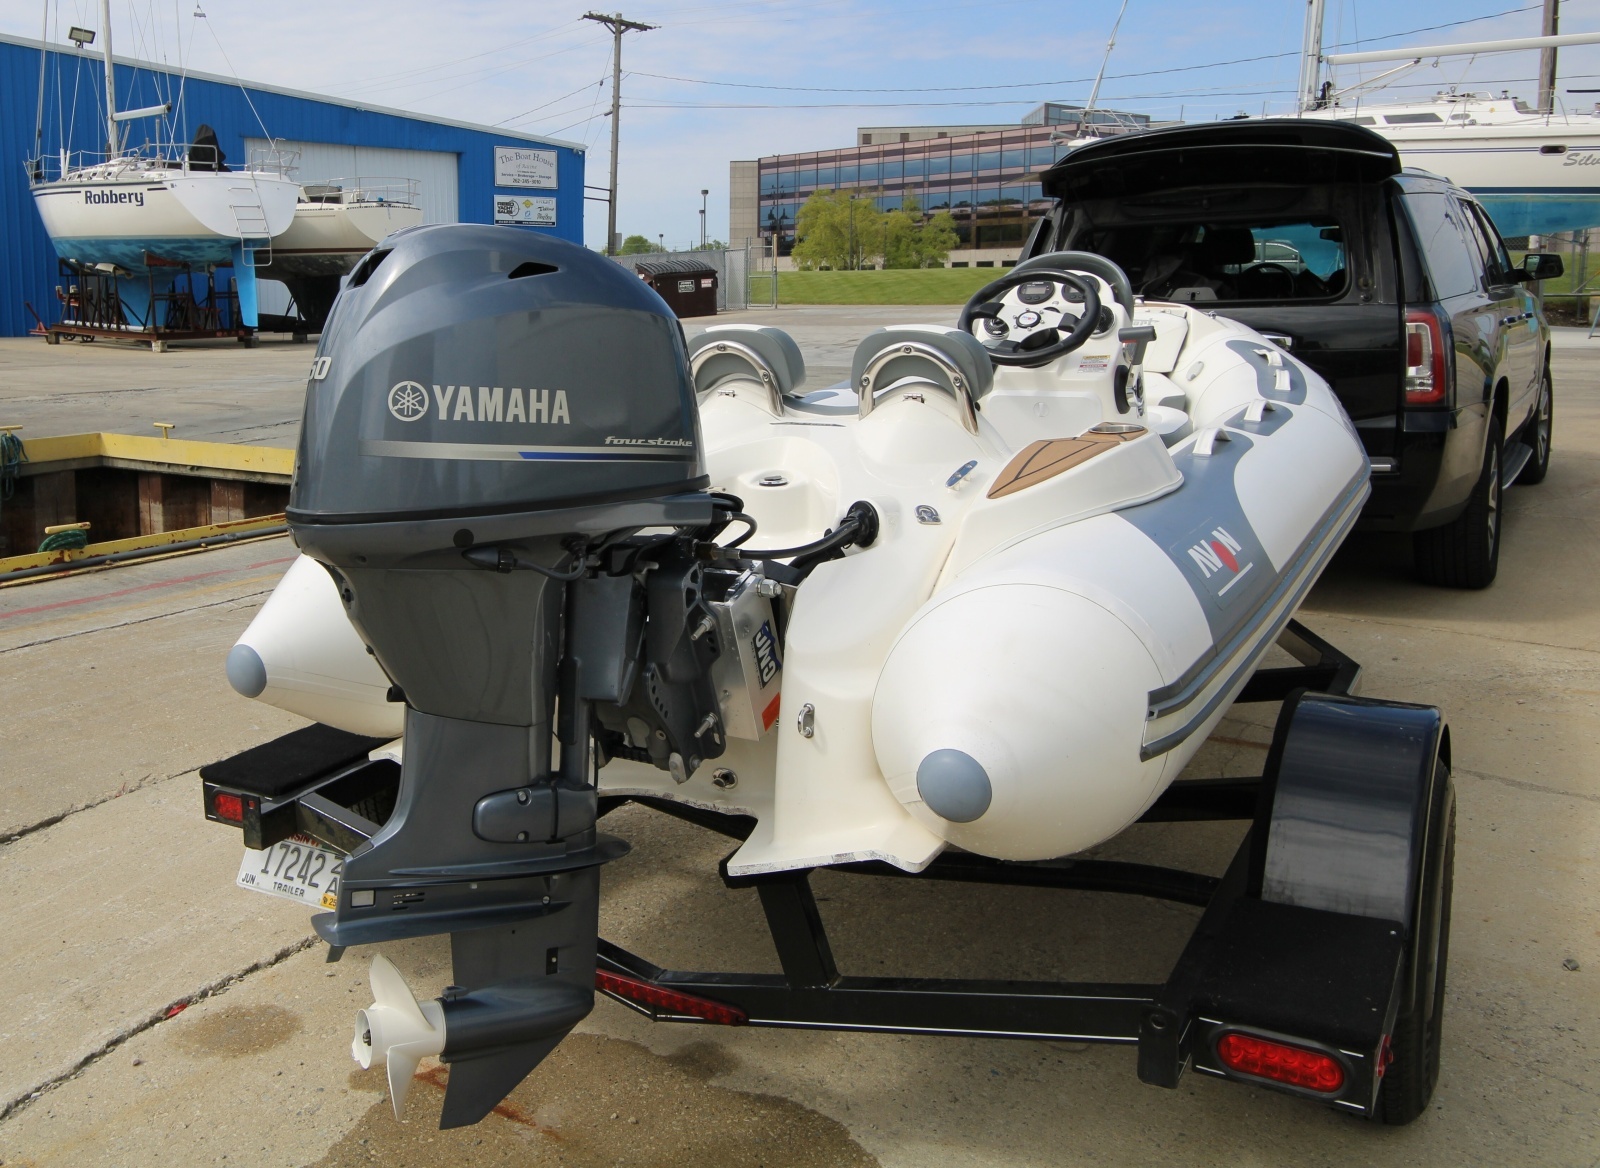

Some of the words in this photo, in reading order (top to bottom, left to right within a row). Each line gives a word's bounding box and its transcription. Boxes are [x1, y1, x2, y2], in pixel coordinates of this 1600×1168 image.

[500, 154, 514, 164] The
[515, 152, 531, 161] Boat
[533, 152, 554, 168] House
[84, 190, 144, 207] Robbery
[432, 384, 571, 425] YAMAHA
[1187, 526, 1242, 578] AVON
[755, 631, 777, 683] CMC
[242, 872, 256, 884] JUN
[261, 843, 326, 888] 17242
[273, 881, 305, 897] TRAILER
